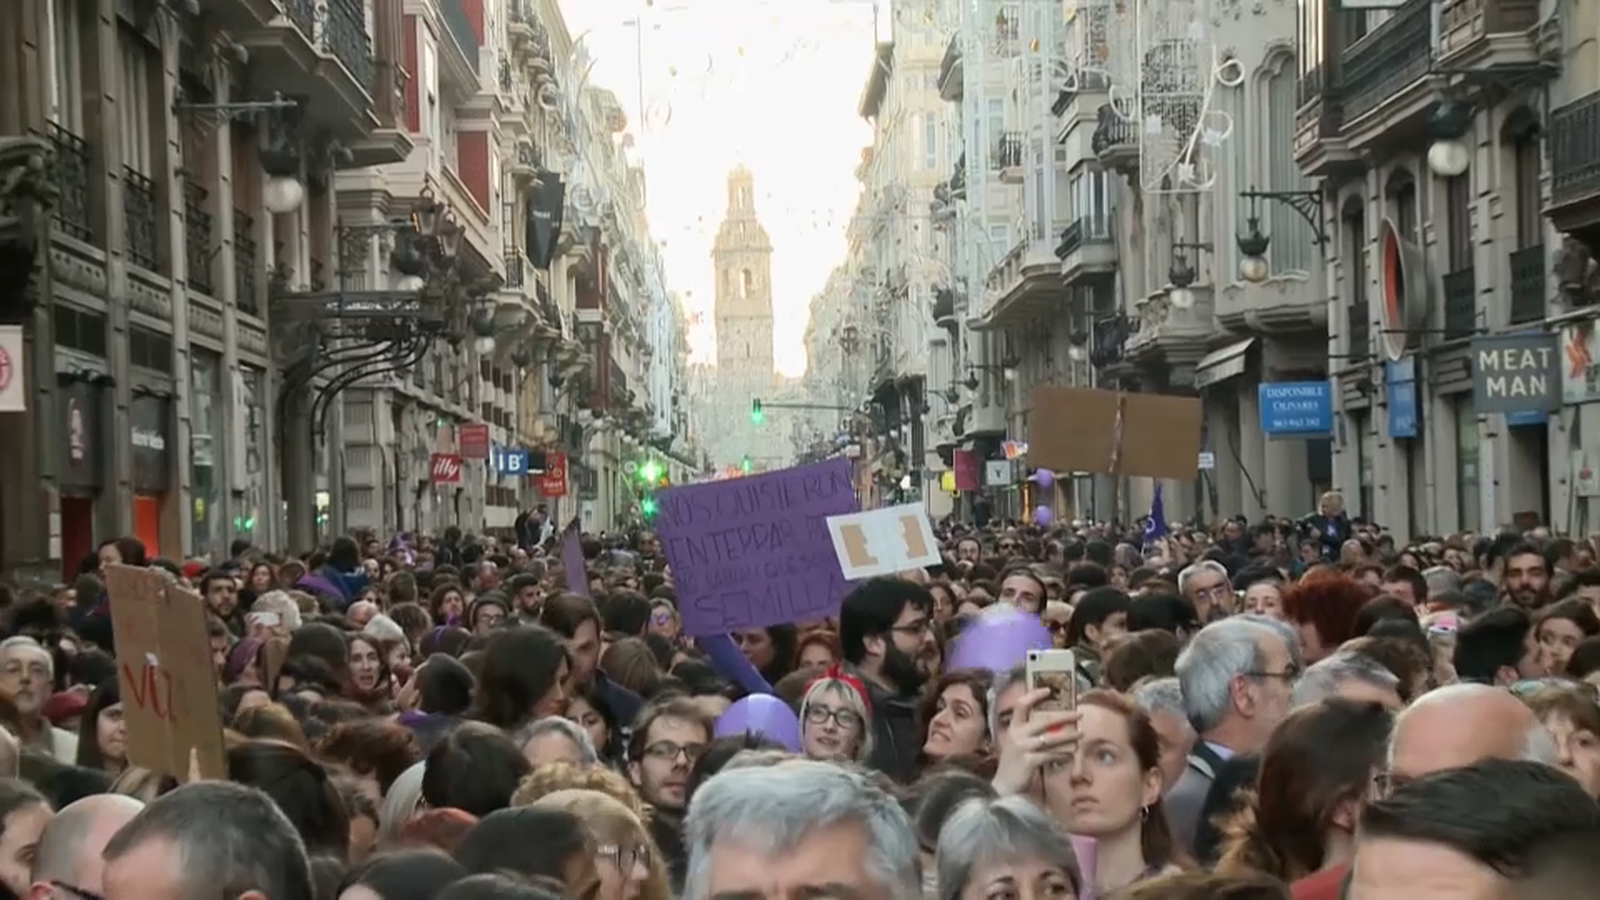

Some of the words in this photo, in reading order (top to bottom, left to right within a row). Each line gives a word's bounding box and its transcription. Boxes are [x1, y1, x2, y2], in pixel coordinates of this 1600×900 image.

[1479, 347, 1553, 372] MEAT
[1266, 385, 1324, 398] DISPONIBLE
[1486, 373, 1547, 398] MAN
[433, 458, 459, 479] illy
[660, 487, 713, 529] NOS
[715, 466, 853, 519] QUISIERON
